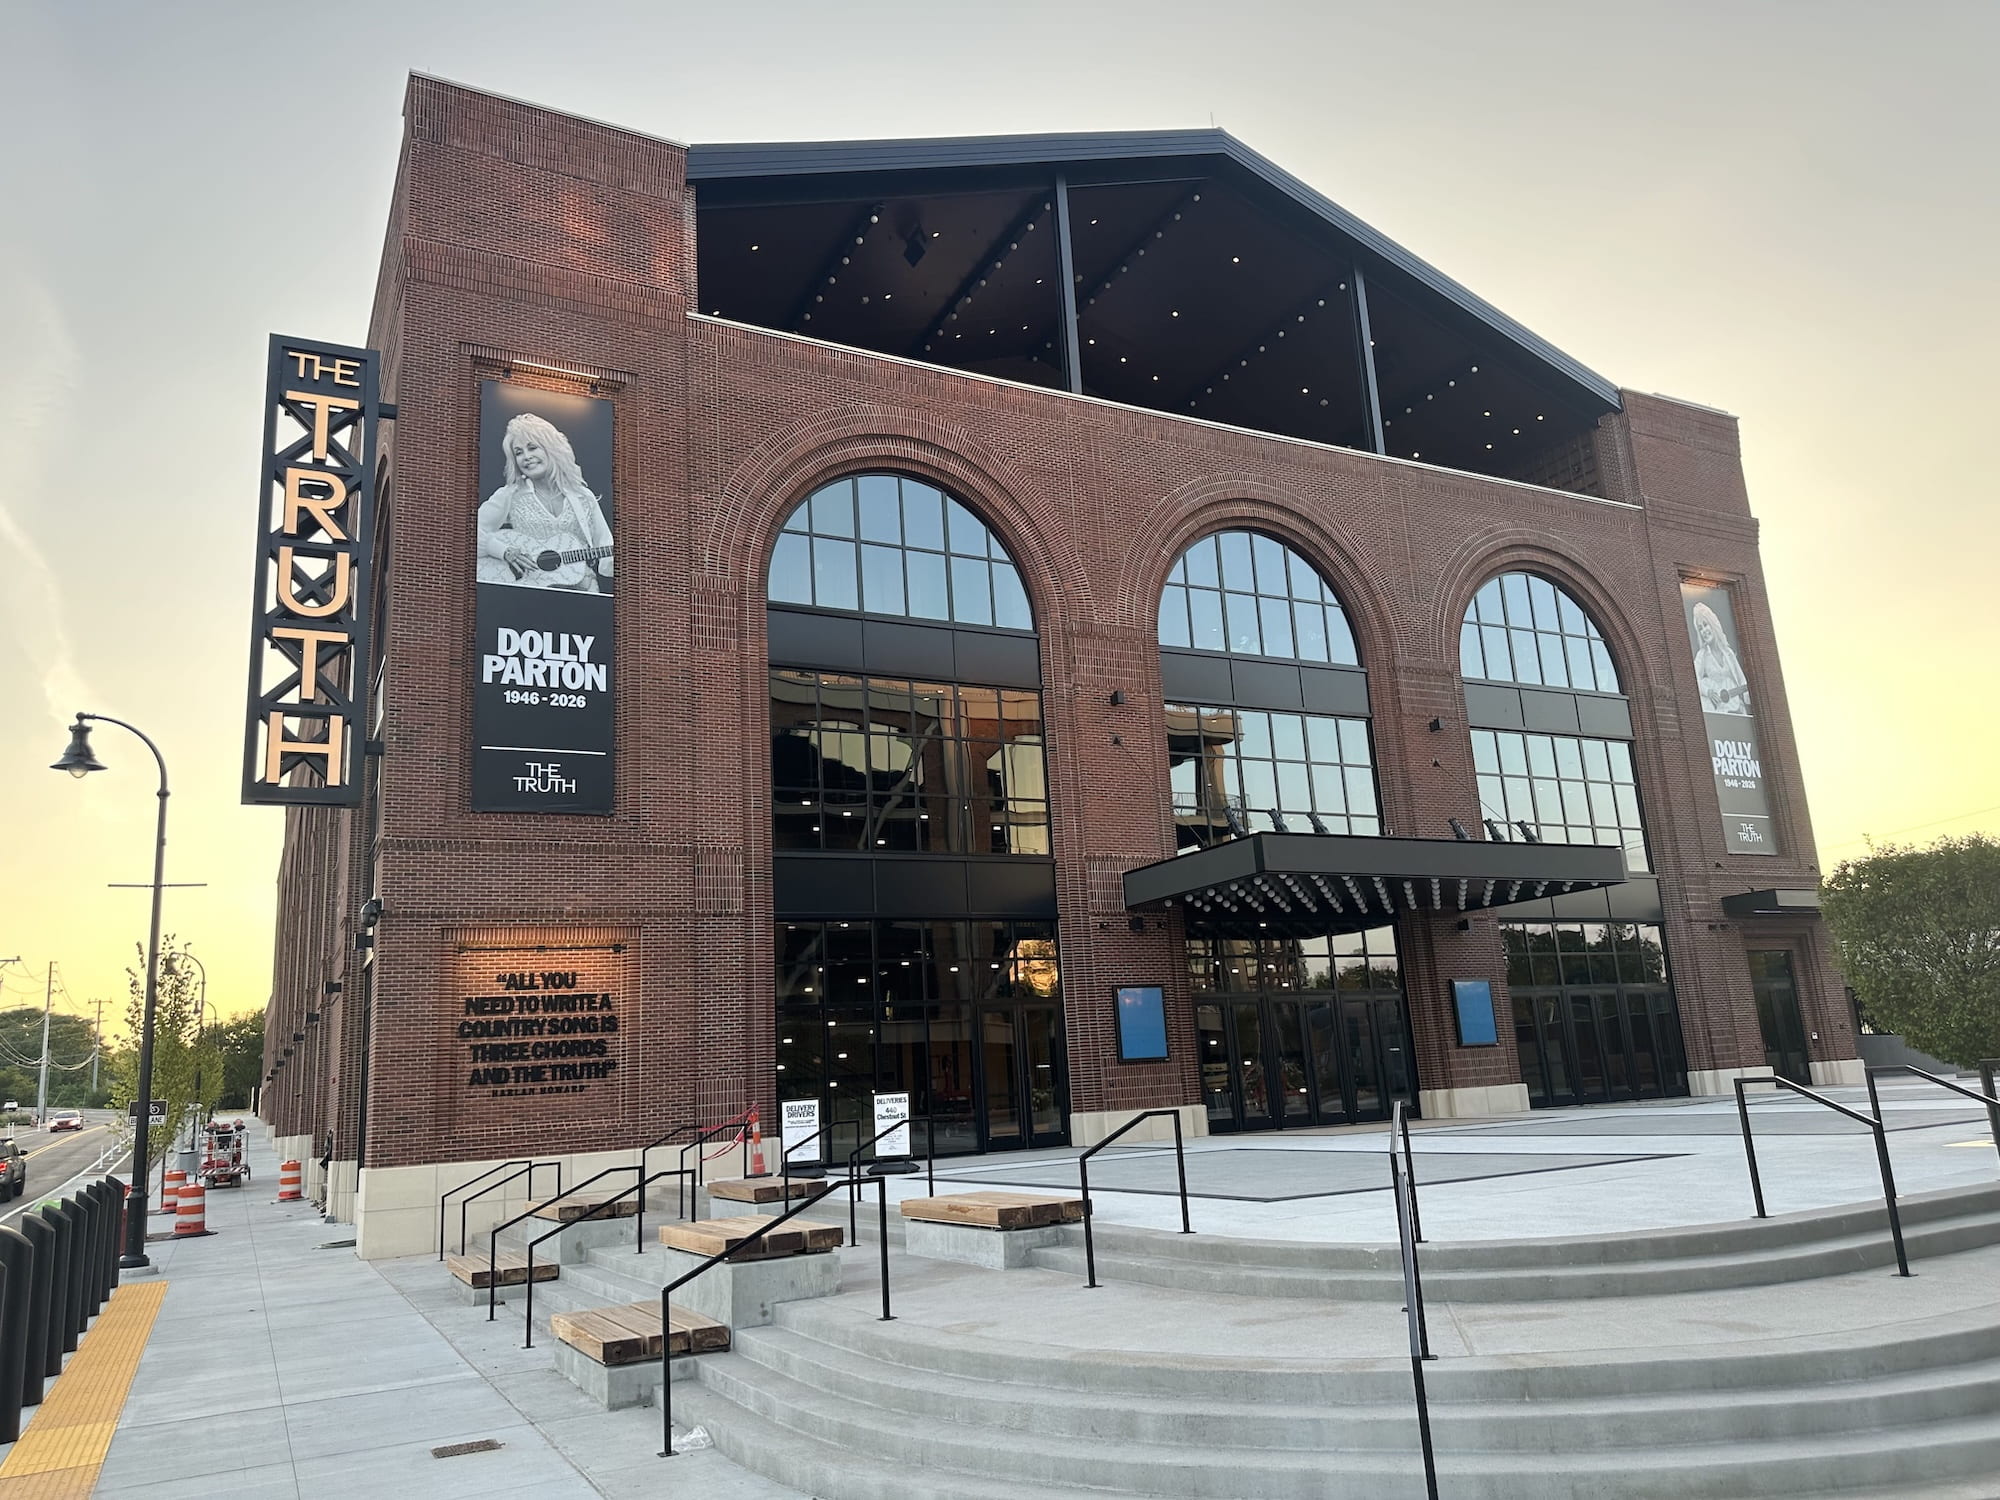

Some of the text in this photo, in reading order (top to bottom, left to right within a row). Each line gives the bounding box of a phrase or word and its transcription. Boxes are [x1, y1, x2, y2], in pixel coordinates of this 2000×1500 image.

[288, 351, 361, 387] THE
[266, 390, 360, 787] TRUTH
[497, 627, 596, 663] DOLLY
[482, 654, 607, 692] PARTON
[1714, 739, 1752, 761] DOLLY
[525, 762, 561, 778] THE
[1712, 756, 1762, 778] PARTON
[512, 776, 577, 794] TRUTH
[1737, 831, 1763, 843] TRUTH
[1740, 823, 1756, 833] THE
[540, 971, 577, 989] YOU
[465, 993, 612, 1015] NEED TO WRITE A
[458, 1015, 618, 1038] COUNTRY SONG IS
[470, 1038, 607, 1062] THREE CHORDS
[469, 1067, 510, 1086] AND
[512, 1064, 549, 1083] THE
[492, 1084, 585, 1097] HARLAN HOWARD
[877, 1096, 907, 1105] DELIVERIES
[786, 1104, 816, 1112] DELIVERY
